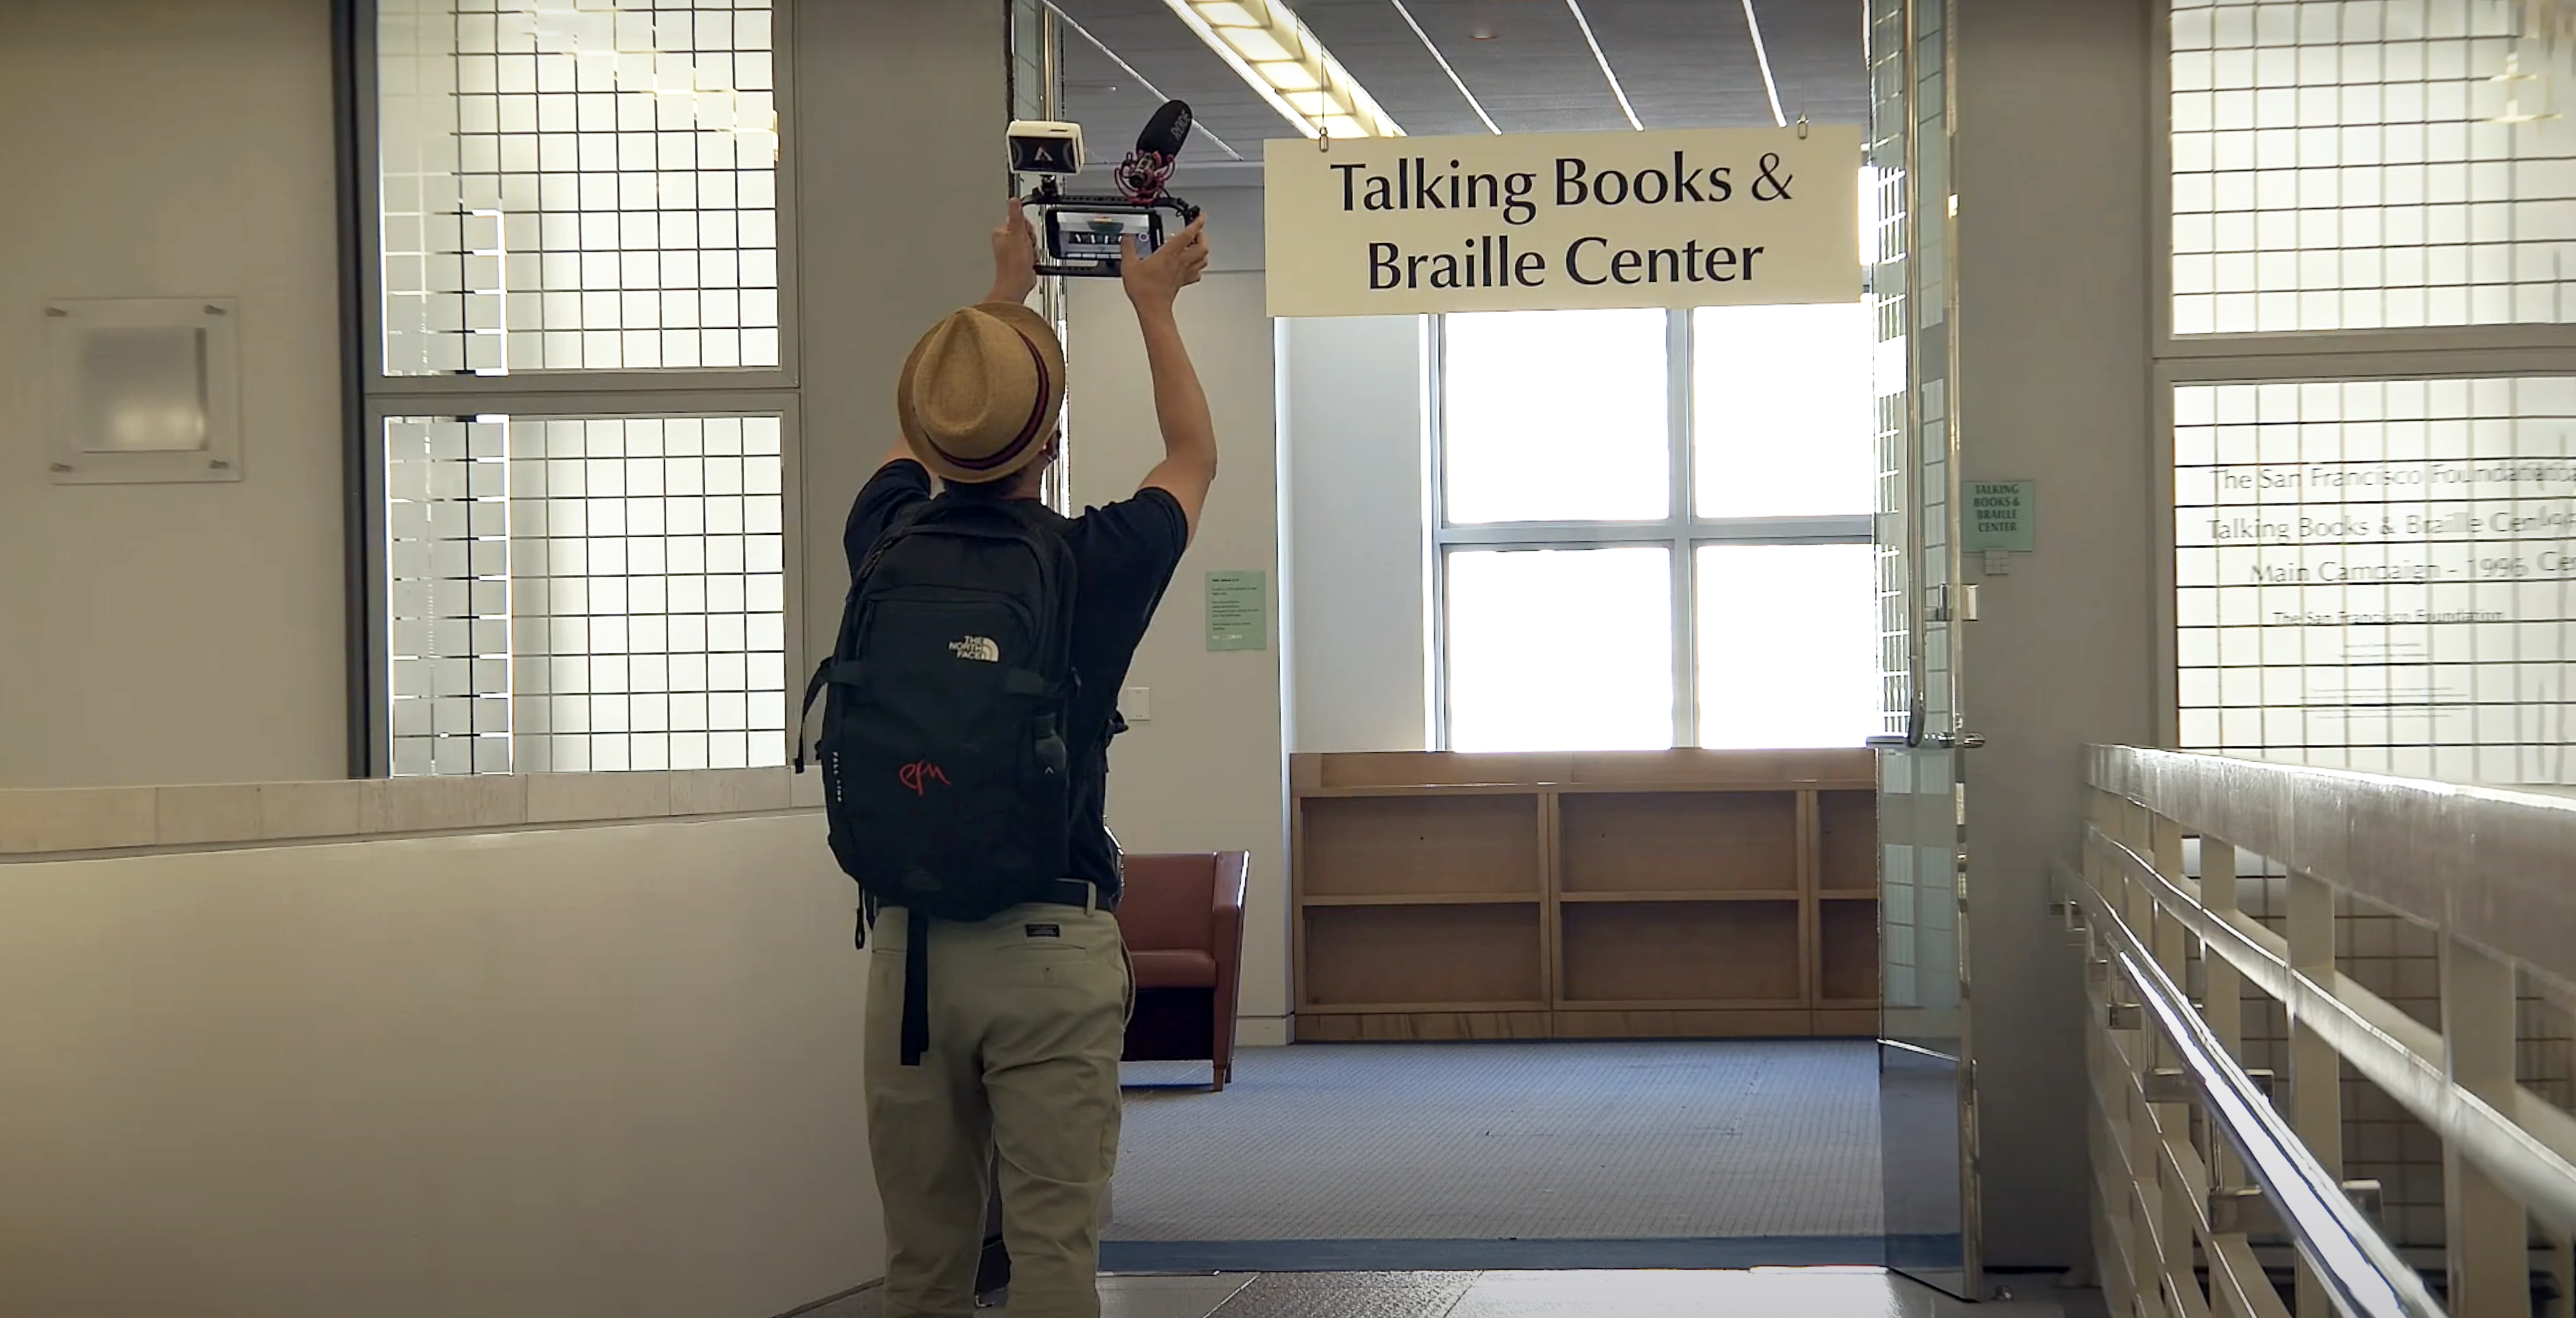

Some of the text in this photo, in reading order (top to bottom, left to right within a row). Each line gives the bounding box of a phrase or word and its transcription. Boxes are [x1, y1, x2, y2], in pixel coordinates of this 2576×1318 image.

[1329, 150, 1795, 226] Talking Books &
[1368, 234, 1765, 290] Braille Center
[2209, 469, 2252, 489] The
[2259, 469, 2301, 489] San
[1975, 484, 2020, 494] TALKING
[1974, 497, 2020, 507] BOOKS &
[1977, 509, 2018, 519] BRAILLE
[1978, 522, 2017, 532] CENTER
[2206, 518, 2291, 544] Talking
[2299, 515, 2369, 538] Books
[2380, 516, 2396, 535] &
[2250, 562, 2310, 582] Main
[2467, 557, 2529, 577] 1996
[964, 635, 982, 644] THE
[948, 641, 982, 651] NORTH
[957, 651, 982, 660] FACE
